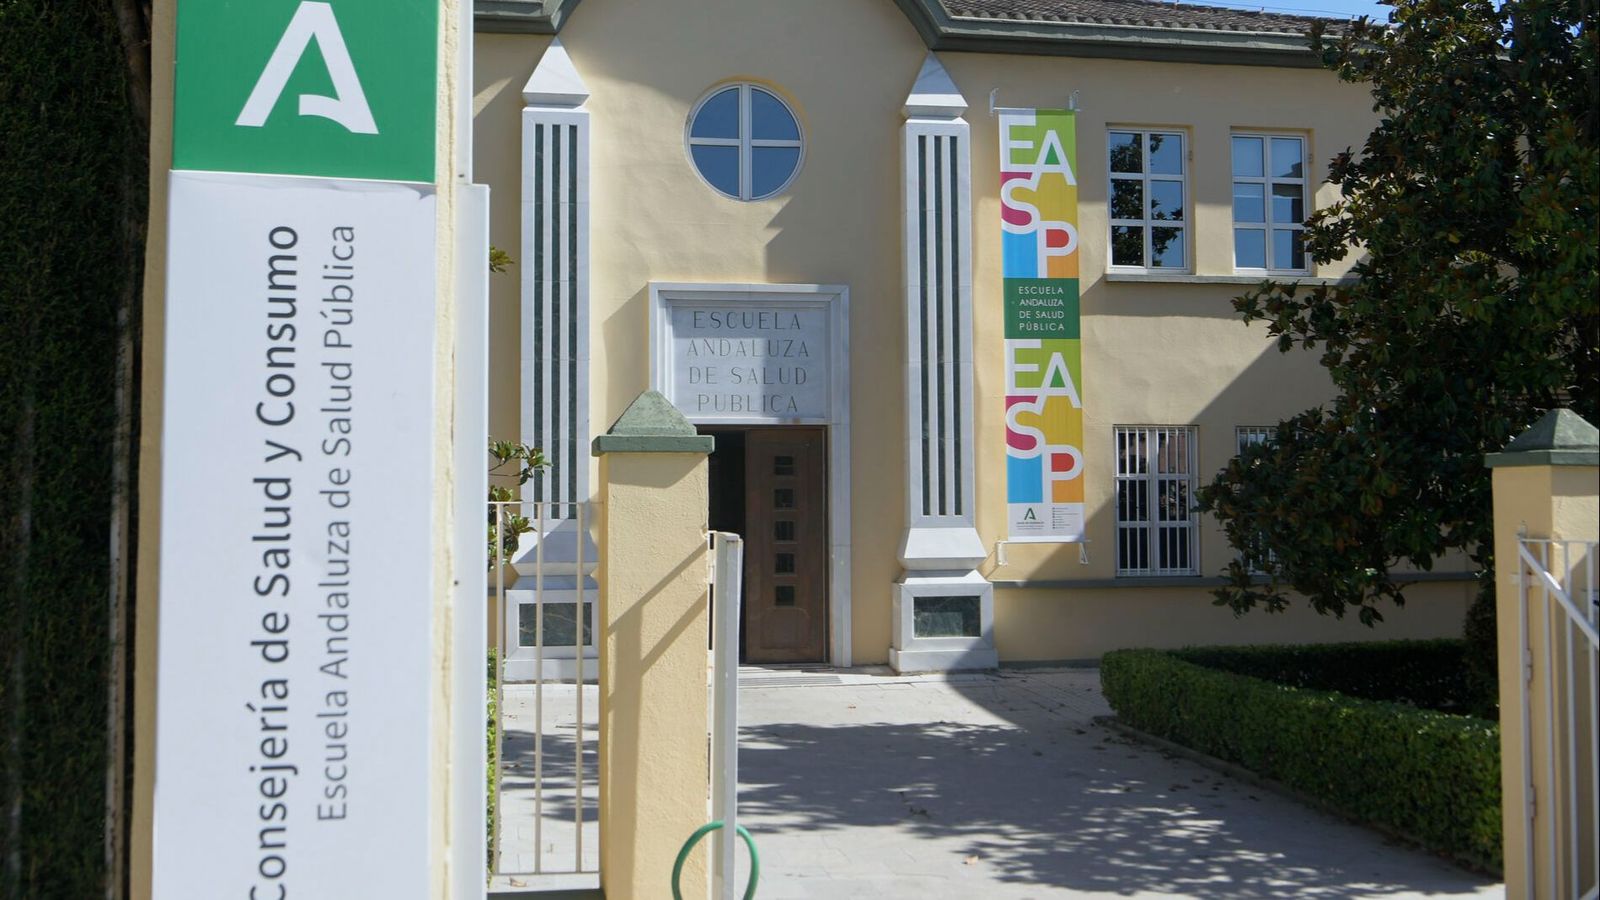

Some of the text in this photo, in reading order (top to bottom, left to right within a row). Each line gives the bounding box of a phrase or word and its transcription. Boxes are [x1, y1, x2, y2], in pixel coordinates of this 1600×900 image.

[1018, 286, 1064, 295] ESCUELA
[1019, 298, 1064, 307] ANDALUZA
[693, 311, 801, 330] ESCUELA
[1018, 310, 1065, 319] DE SALUD
[1018, 321, 1065, 331] PÚBLICA
[687, 338, 809, 358] ANDALUZA
[689, 366, 807, 386] DE SALUD
[697, 393, 798, 413] PUBLICA
[316, 226, 355, 821] Escuela Andaluza de Salud Pública
[246, 226, 303, 900] Consejería de Salud y Consumo
